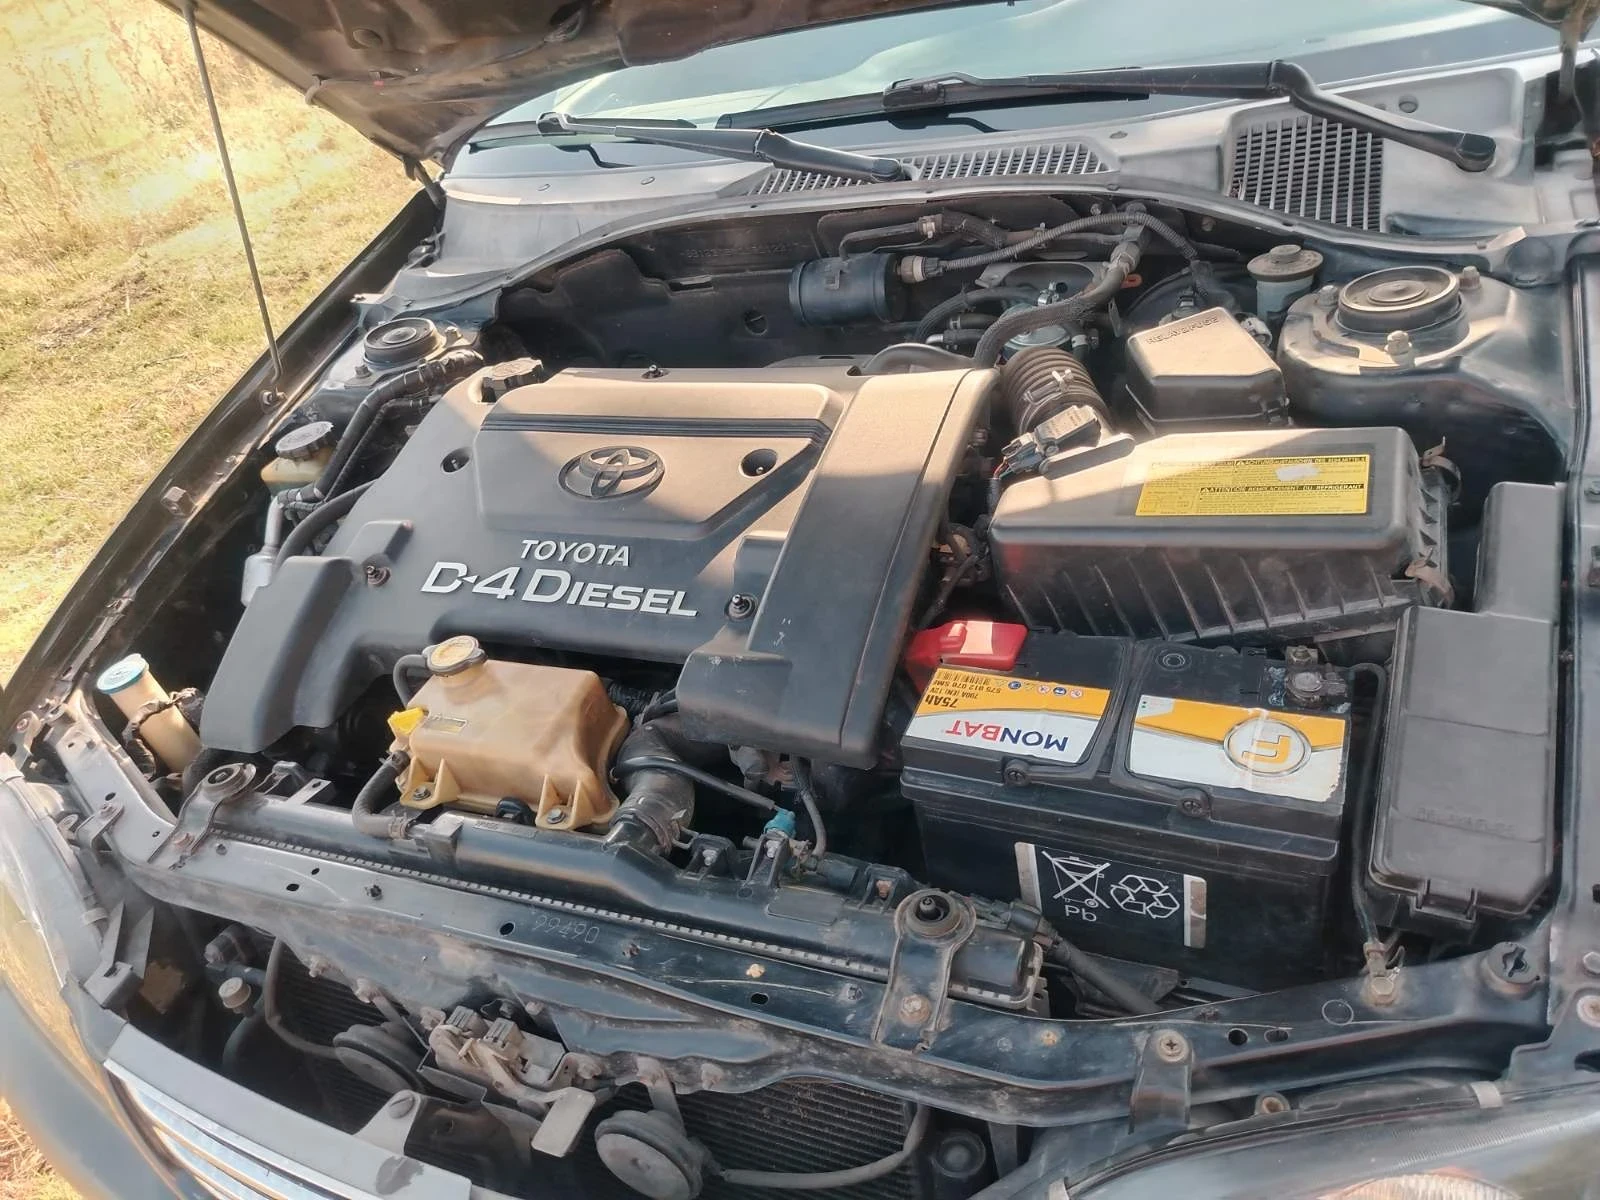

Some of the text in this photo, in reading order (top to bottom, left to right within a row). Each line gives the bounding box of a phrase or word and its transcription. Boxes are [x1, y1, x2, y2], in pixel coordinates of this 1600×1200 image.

[520, 539, 630, 567] TOYOTA
[521, 568, 699, 617] DIESEL
[925, 694, 959, 708] 75Ah
[945, 719, 1069, 752] MONBAT
[1064, 905, 1097, 922] Pb
